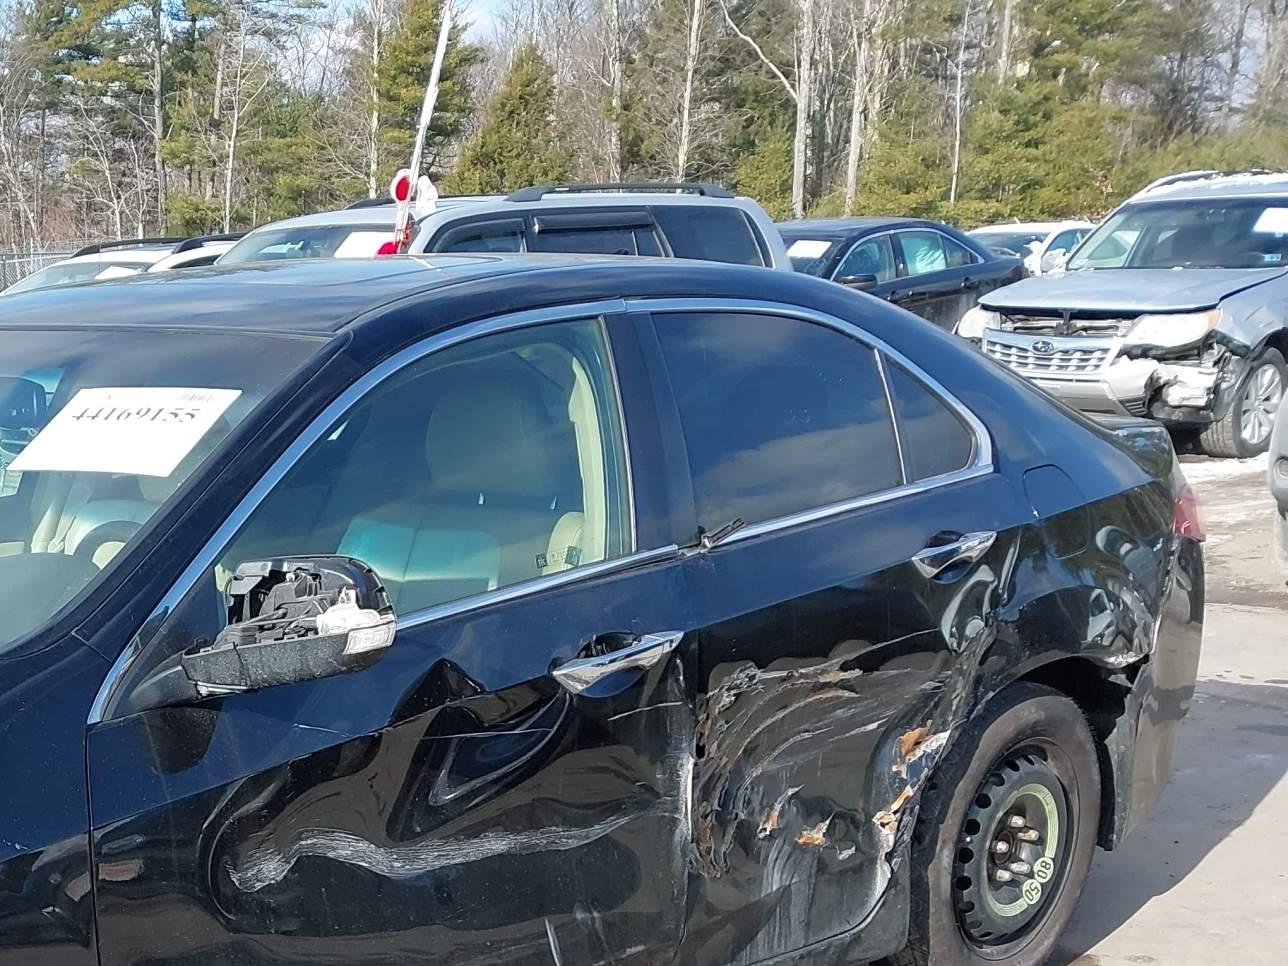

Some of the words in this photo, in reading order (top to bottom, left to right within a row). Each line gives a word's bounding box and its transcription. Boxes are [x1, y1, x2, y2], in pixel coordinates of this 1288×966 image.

[72, 407, 201, 423] 44169155
[1036, 860, 1052, 880] 80
[1024, 882, 1041, 902] 50
